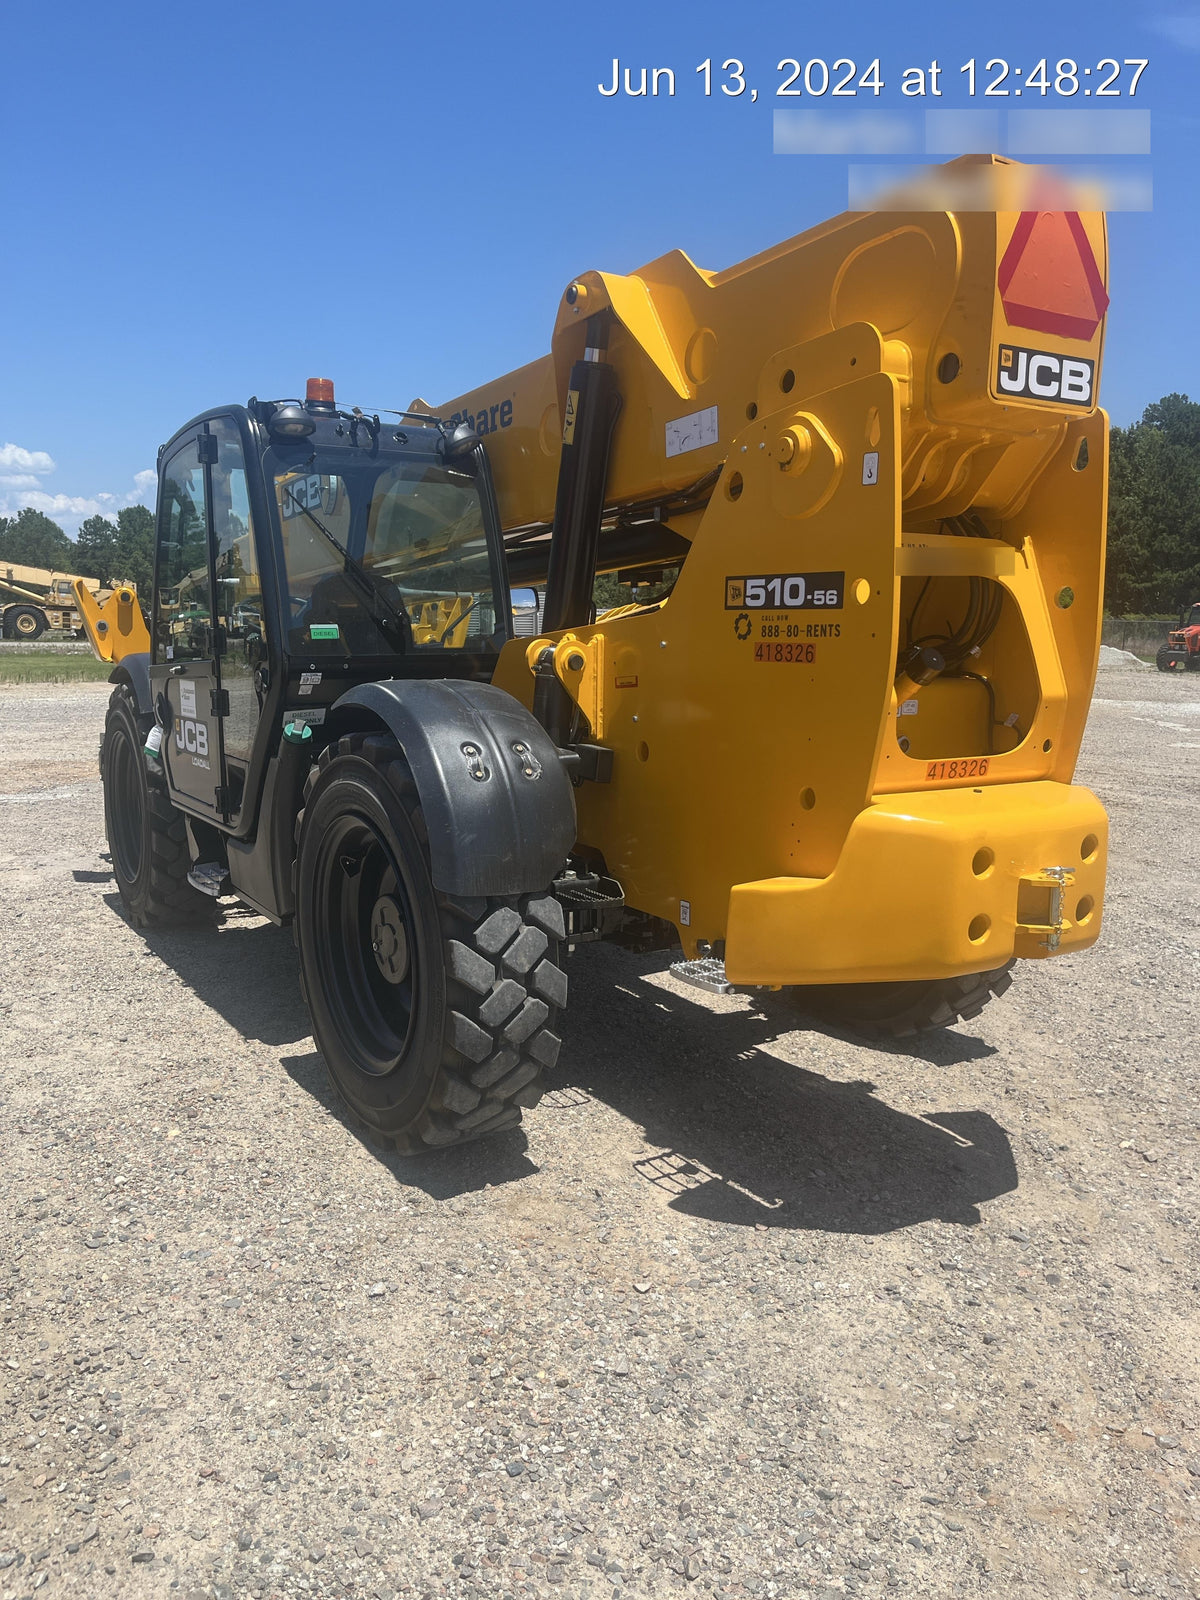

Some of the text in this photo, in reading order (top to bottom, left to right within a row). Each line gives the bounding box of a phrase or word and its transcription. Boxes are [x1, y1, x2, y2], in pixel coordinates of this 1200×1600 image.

[1000, 352, 1091, 401] JCB
[282, 474, 321, 518] JCB
[761, 624, 841, 638] 888-80-RENTS
[755, 643, 815, 663] 418326
[176, 720, 208, 756] JCB
[927, 759, 988, 780] 418326
